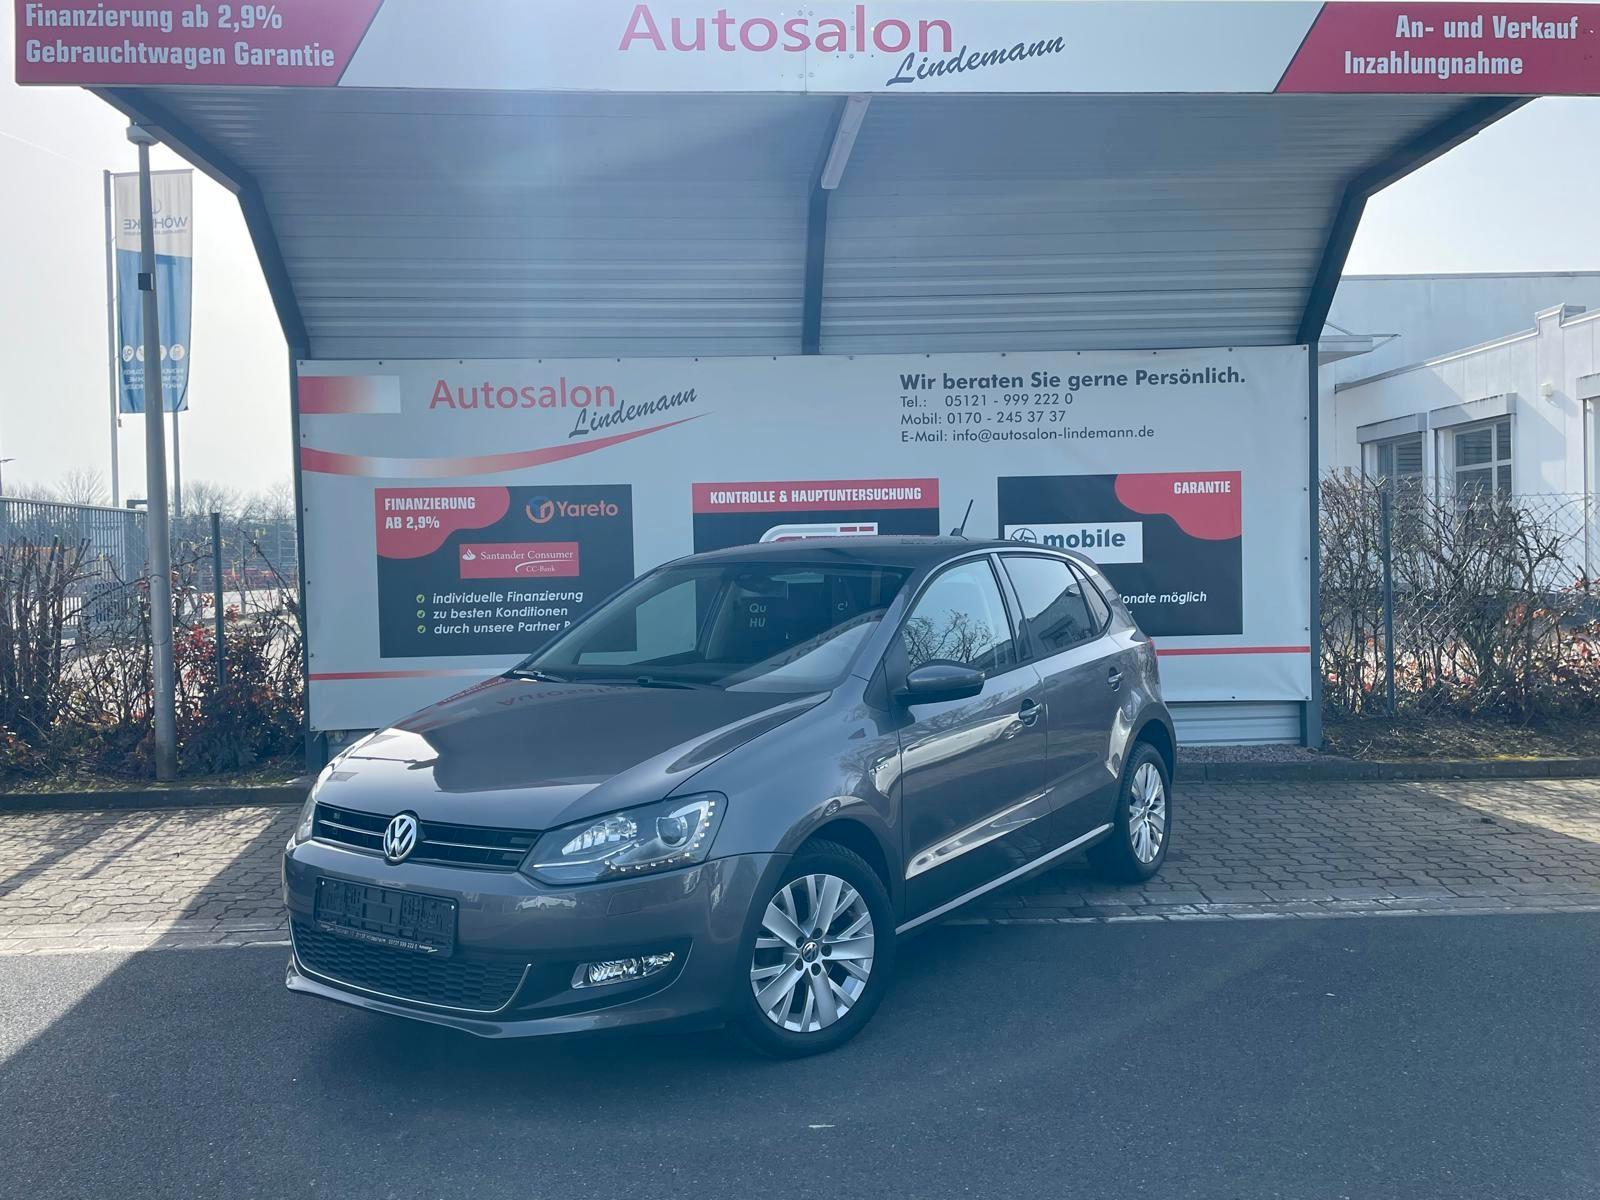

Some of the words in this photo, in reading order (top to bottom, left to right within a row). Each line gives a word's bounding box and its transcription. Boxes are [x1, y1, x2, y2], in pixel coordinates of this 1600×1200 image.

[25, 3, 173, 33] Finanzierung
[181, 4, 209, 28] ab
[217, 4, 282, 33] 2,9%
[618, 4, 953, 52] Autosalon
[1395, 15, 1434, 38] An-
[1443, 15, 1483, 39] und
[1492, 15, 1578, 40] Verkauf
[26, 39, 226, 70] Gebrauchtwagen
[234, 41, 335, 67] Garantie
[885, 36, 1065, 87] Lindemann
[1344, 50, 1524, 80] Inzahlungnahme
[900, 374, 936, 390] Wir
[943, 372, 1024, 390] beraten
[1030, 371, 1061, 388] Sie
[1068, 374, 1128, 391] gerne
[1135, 366, 1246, 386] Persönlich.
[429, 377, 615, 409] Autosalon
[900, 395, 927, 408] Tel.:
[945, 394, 987, 407] 05121
[1003, 393, 1029, 406] 999
[1034, 393, 1060, 405] 222
[1064, 393, 1073, 405] 0
[568, 388, 697, 438] Lindemann
[900, 413, 942, 425] Mobil:
[947, 412, 982, 424] 0170
[996, 411, 1023, 423] 245
[1027, 410, 1044, 423] 37
[1049, 410, 1066, 422] 37
[901, 429, 948, 442] E-Mail:
[953, 425, 1155, 443] info@autosalon-lindemann.de
[710, 490, 776, 504] KONTROLLE
[779, 489, 788, 502] &
[791, 487, 922, 502] HAUPTUNTERSUCHUNG
[1173, 480, 1231, 495] GARANTIE
[384, 496, 476, 511] FINANZIERUNG
[557, 499, 618, 517] Yareto
[385, 516, 402, 529] AB
[406, 515, 440, 531] 2,9%
[1043, 528, 1126, 549] mobile
[480, 550, 525, 560] Santander
[527, 549, 574, 560] Consumer
[526, 565, 556, 573] CC-Bank
[432, 591, 504, 604] individuelle
[507, 590, 583, 603] Finanzierung
[1119, 592, 1157, 604] onate
[1159, 591, 1208, 605] möglich
[433, 609, 447, 619] zu
[450, 607, 492, 619] besten
[495, 606, 568, 618] Konditionen
[434, 623, 470, 635] durch
[473, 622, 514, 634] unsere
[517, 620, 561, 632] Partner
